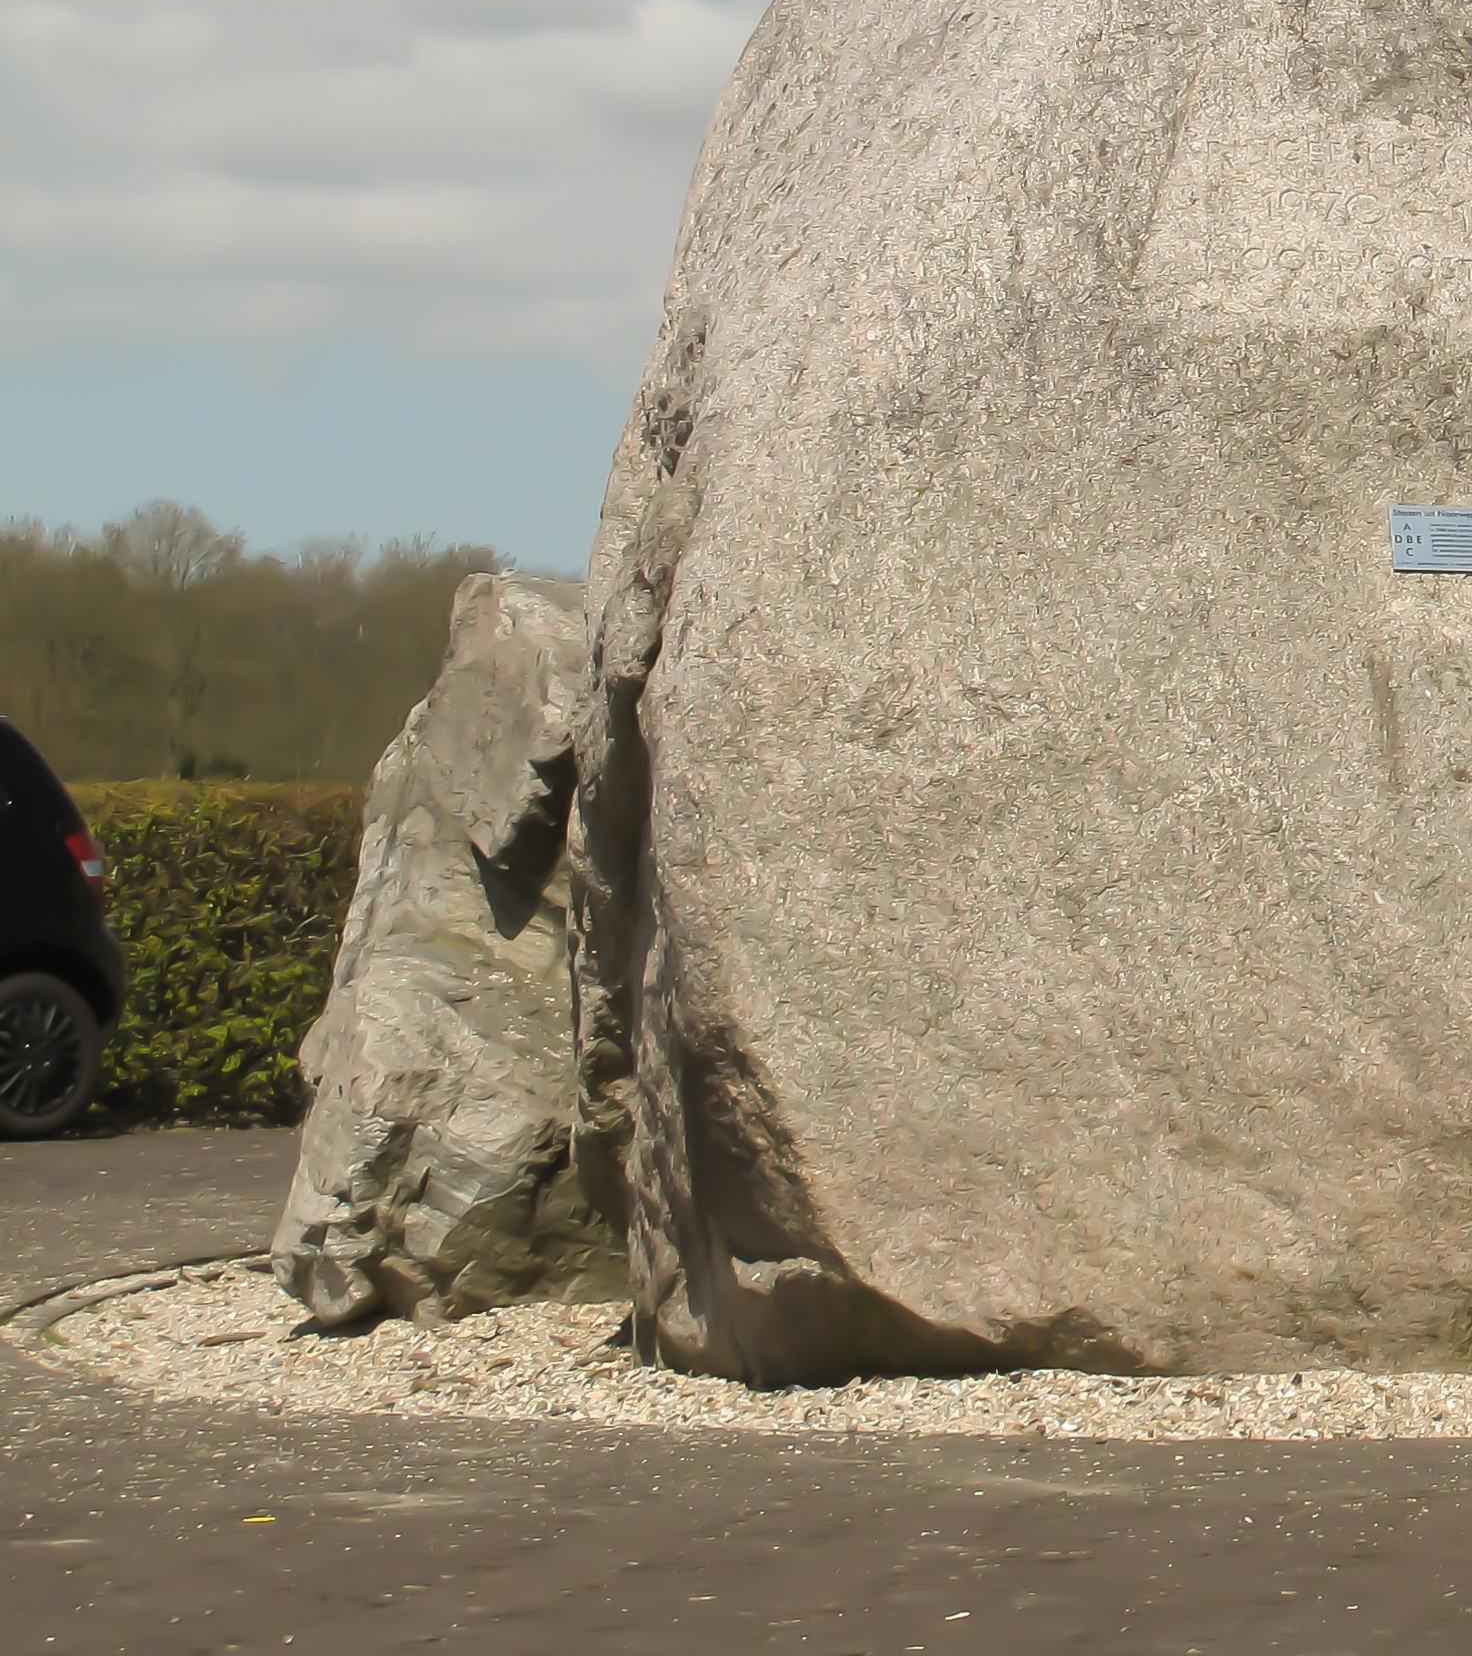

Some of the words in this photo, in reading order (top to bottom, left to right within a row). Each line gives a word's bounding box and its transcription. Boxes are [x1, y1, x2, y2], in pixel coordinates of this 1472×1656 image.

[1403, 523, 1411, 531] A
[1395, 535, 1402, 544] D
[1406, 535, 1413, 544] B
[1417, 535, 1422, 544] E
[1406, 548, 1414, 556] C
